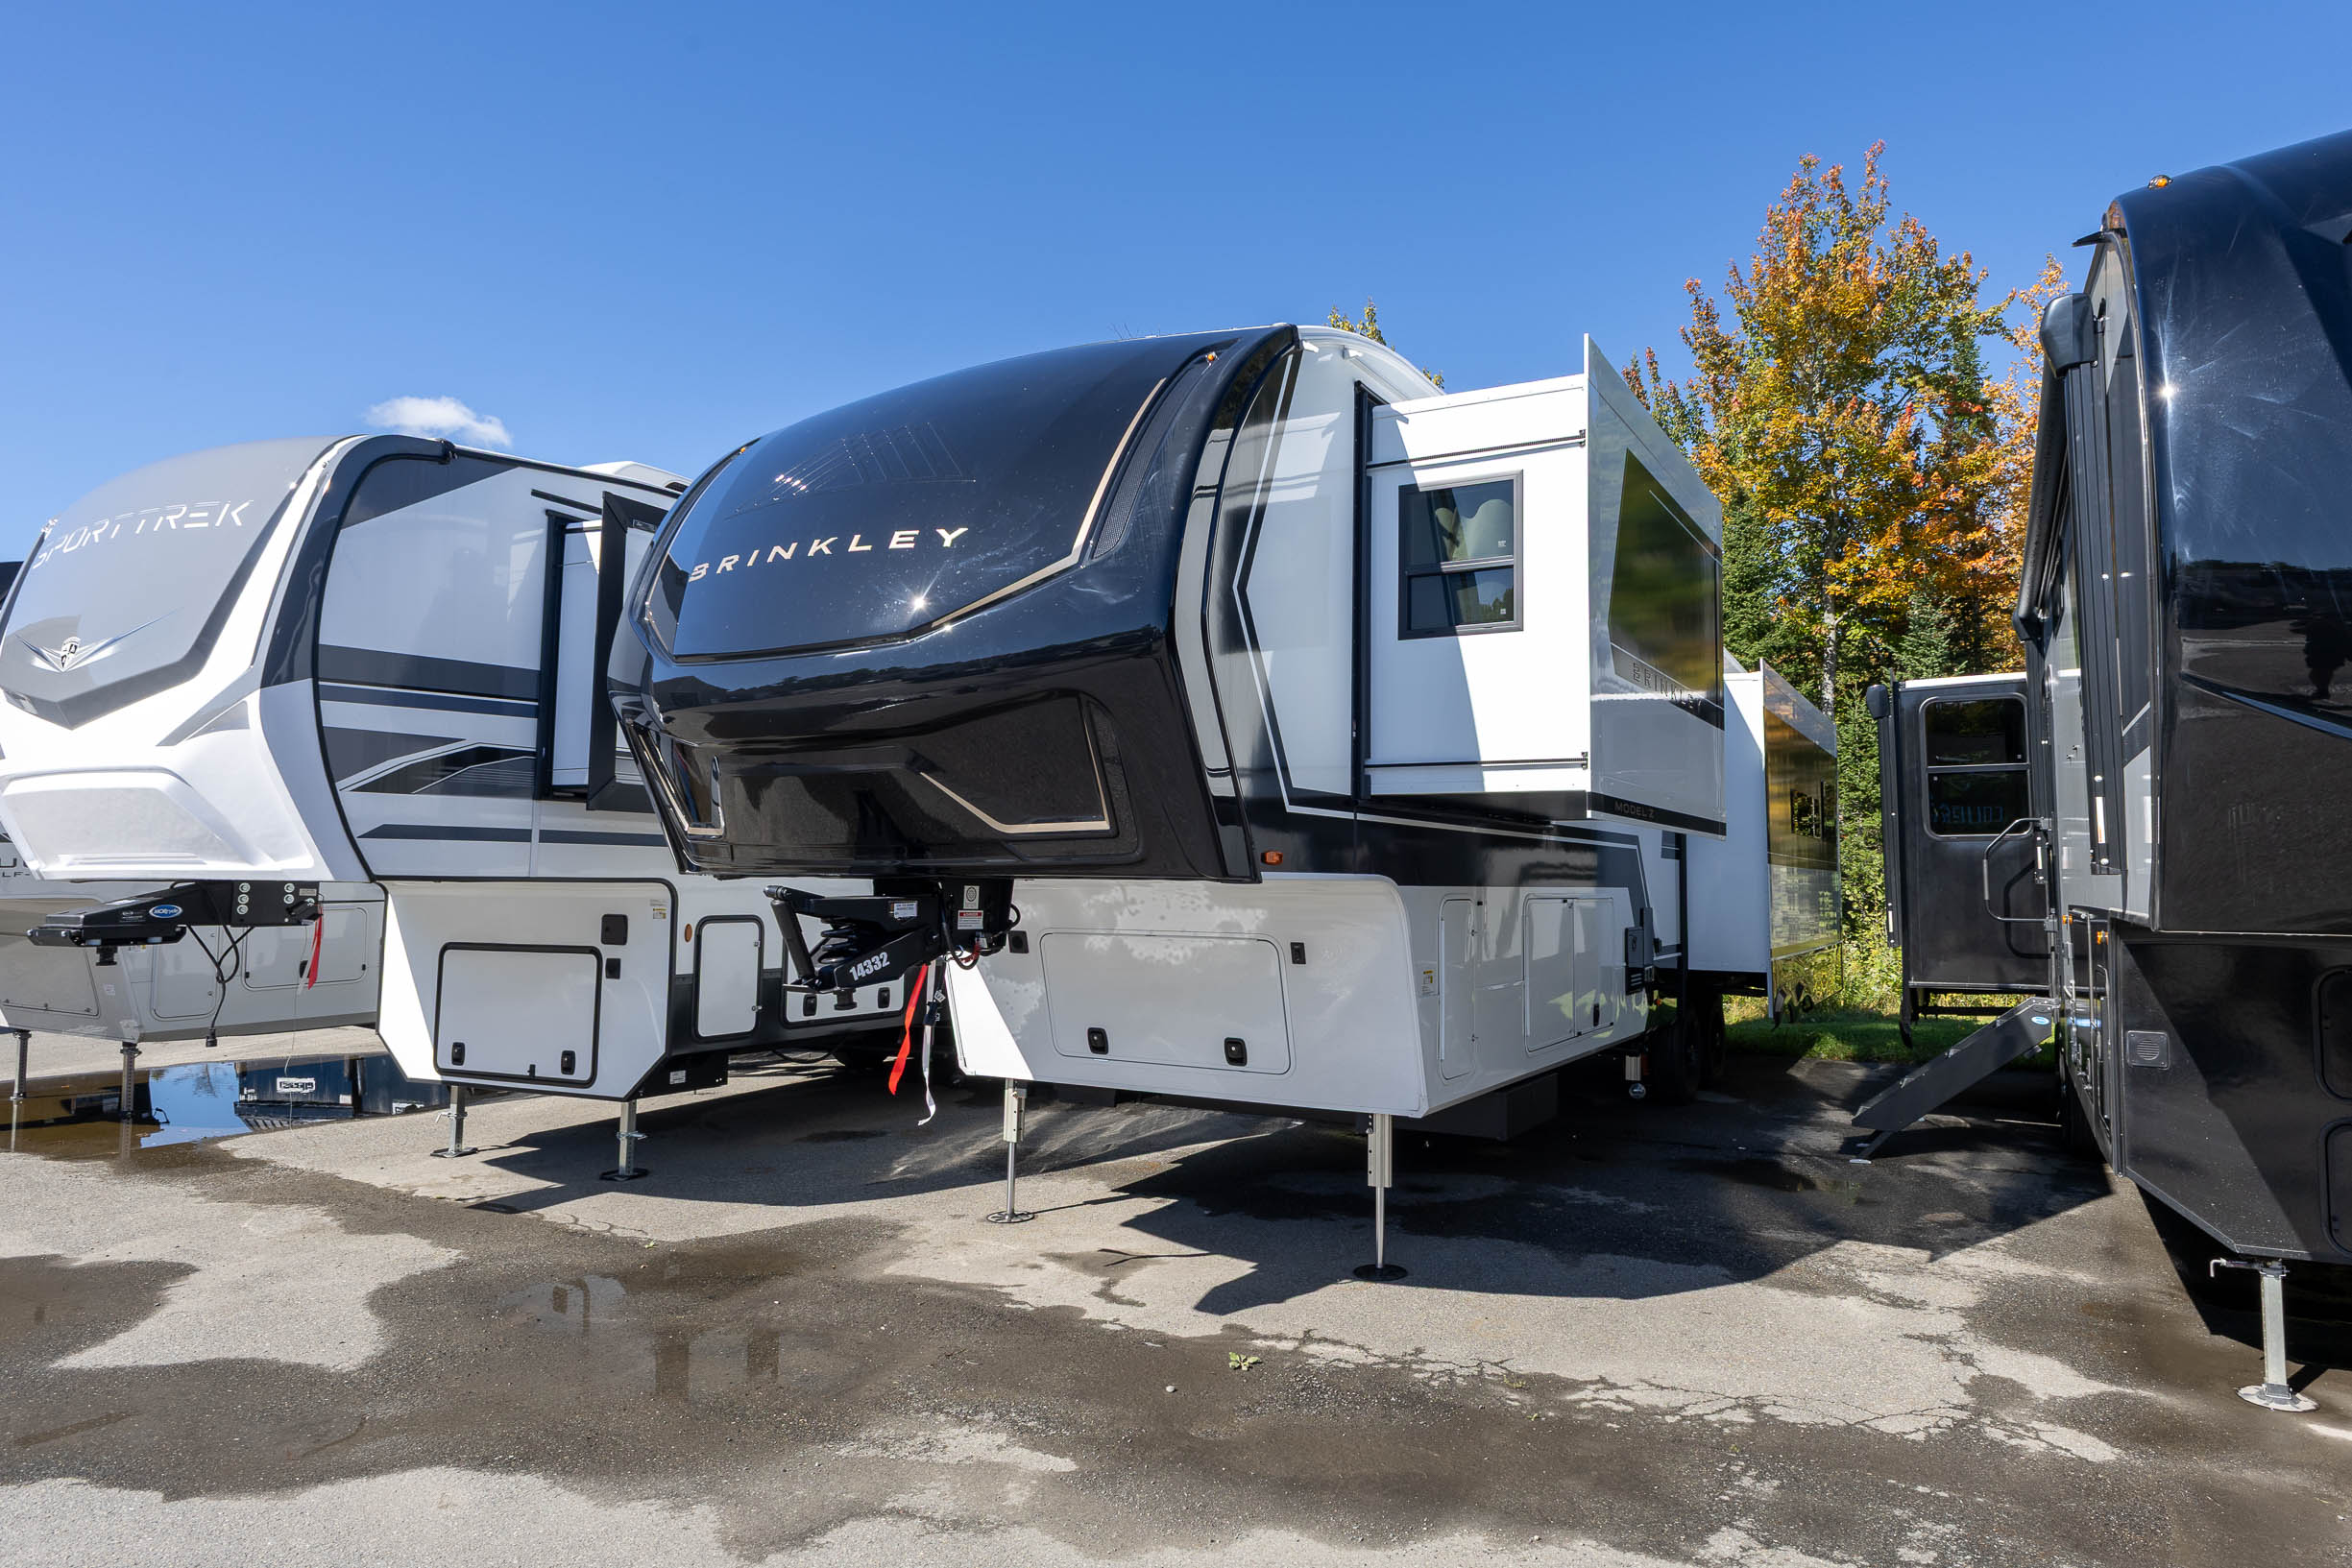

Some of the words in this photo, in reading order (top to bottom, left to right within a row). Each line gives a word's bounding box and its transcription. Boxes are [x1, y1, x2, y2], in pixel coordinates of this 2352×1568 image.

[33, 499, 254, 569] SPORTTREK
[688, 527, 968, 583] BRINKLEY
[1614, 801, 1648, 816] MODEL
[849, 952, 890, 981] 14332
